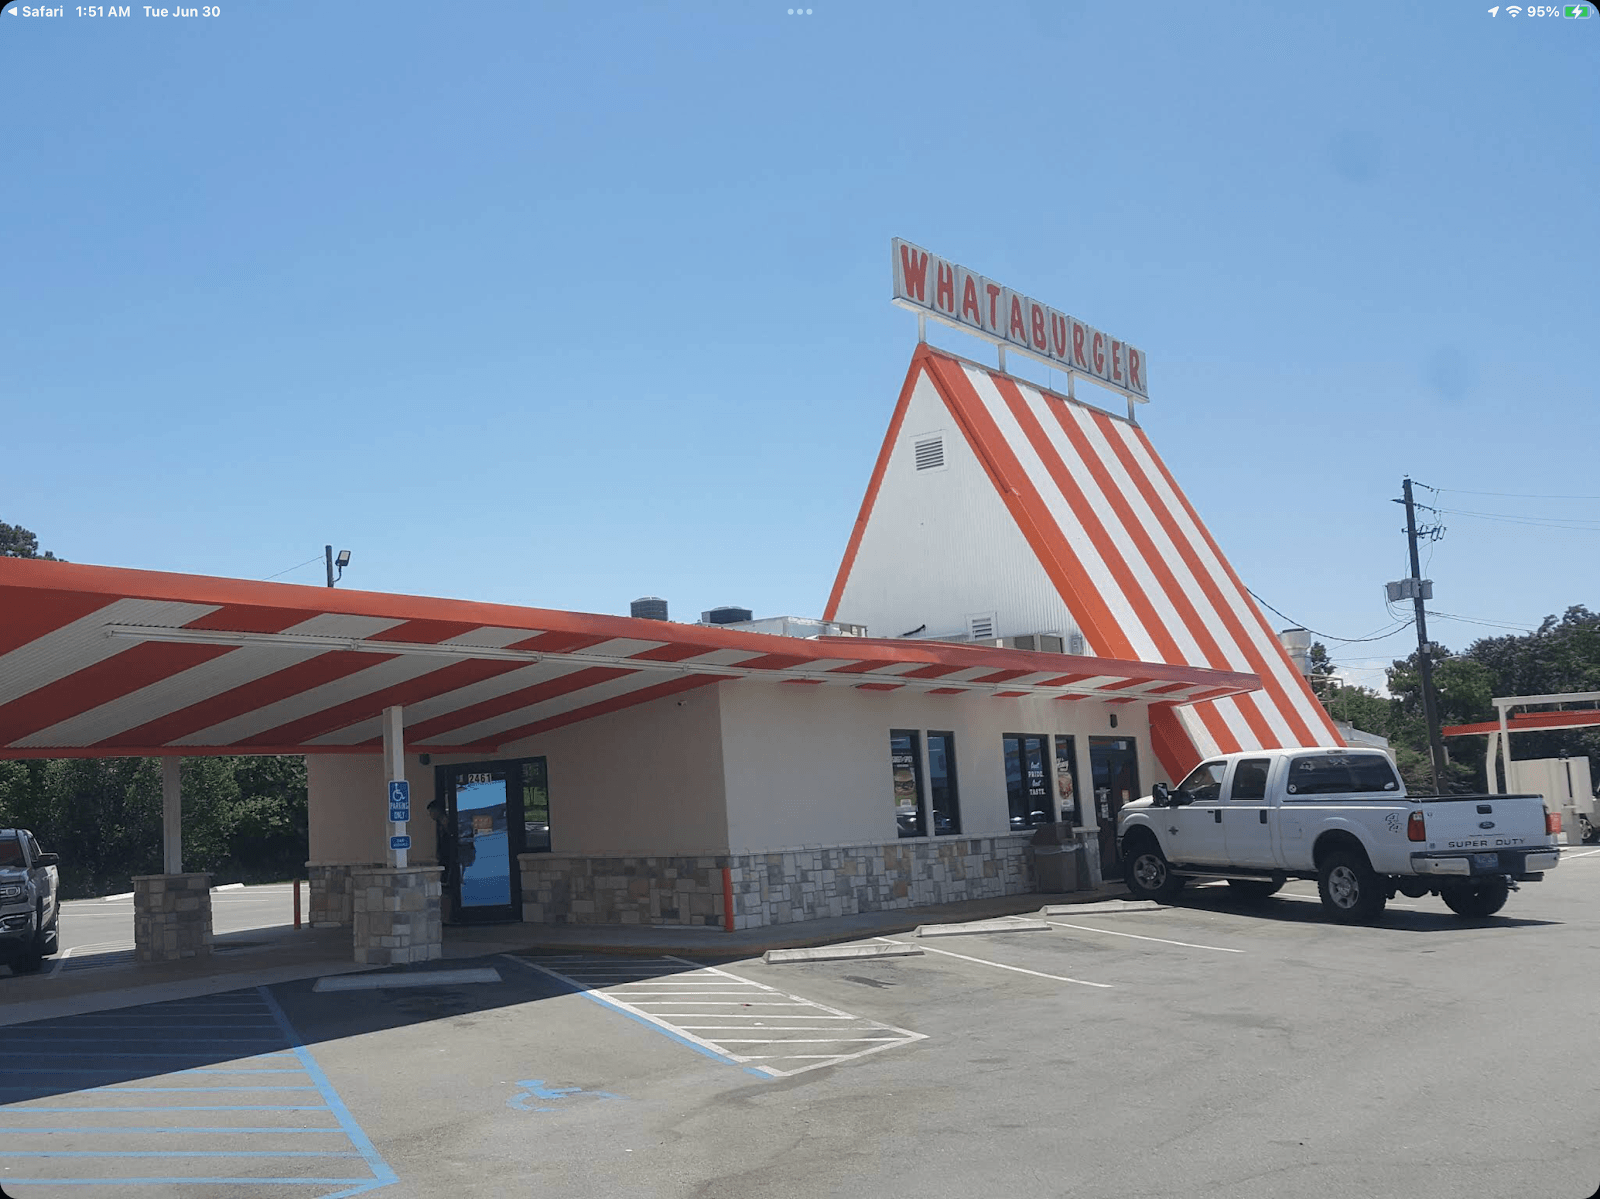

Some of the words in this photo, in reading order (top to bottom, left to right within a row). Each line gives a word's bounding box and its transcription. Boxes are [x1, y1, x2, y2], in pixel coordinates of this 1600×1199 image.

[900, 244, 1143, 392] WHATABURGER
[469, 773, 491, 783] 2461
[1447, 840, 1488, 848] SUPER
[1495, 838, 1525, 846] DUTY
